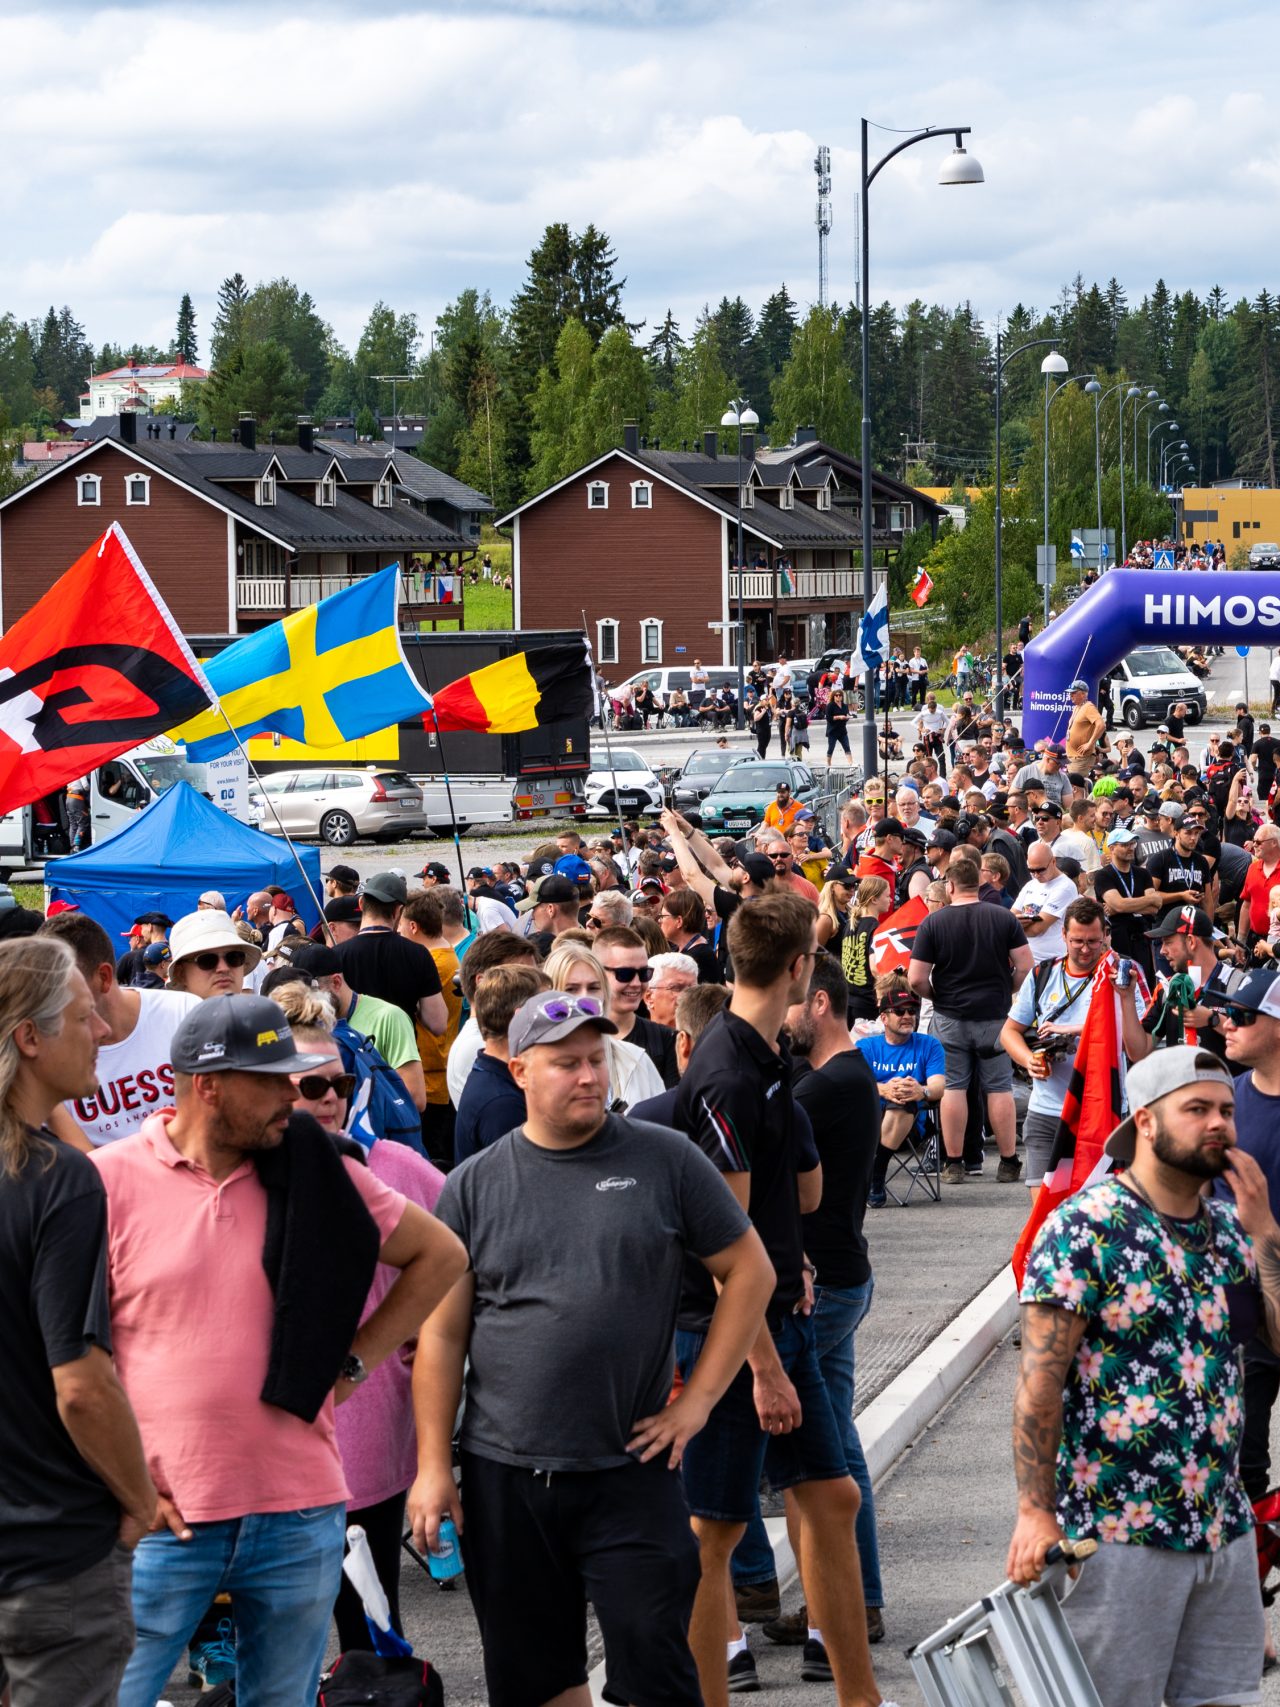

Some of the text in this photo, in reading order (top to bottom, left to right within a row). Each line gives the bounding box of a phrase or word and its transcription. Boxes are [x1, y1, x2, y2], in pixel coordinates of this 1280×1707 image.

[220, 760, 232, 768] YOUR
[233, 758, 245, 766] VISIT
[73, 1063, 176, 1122] GUESS
[98, 1120, 120, 1133] LOS
